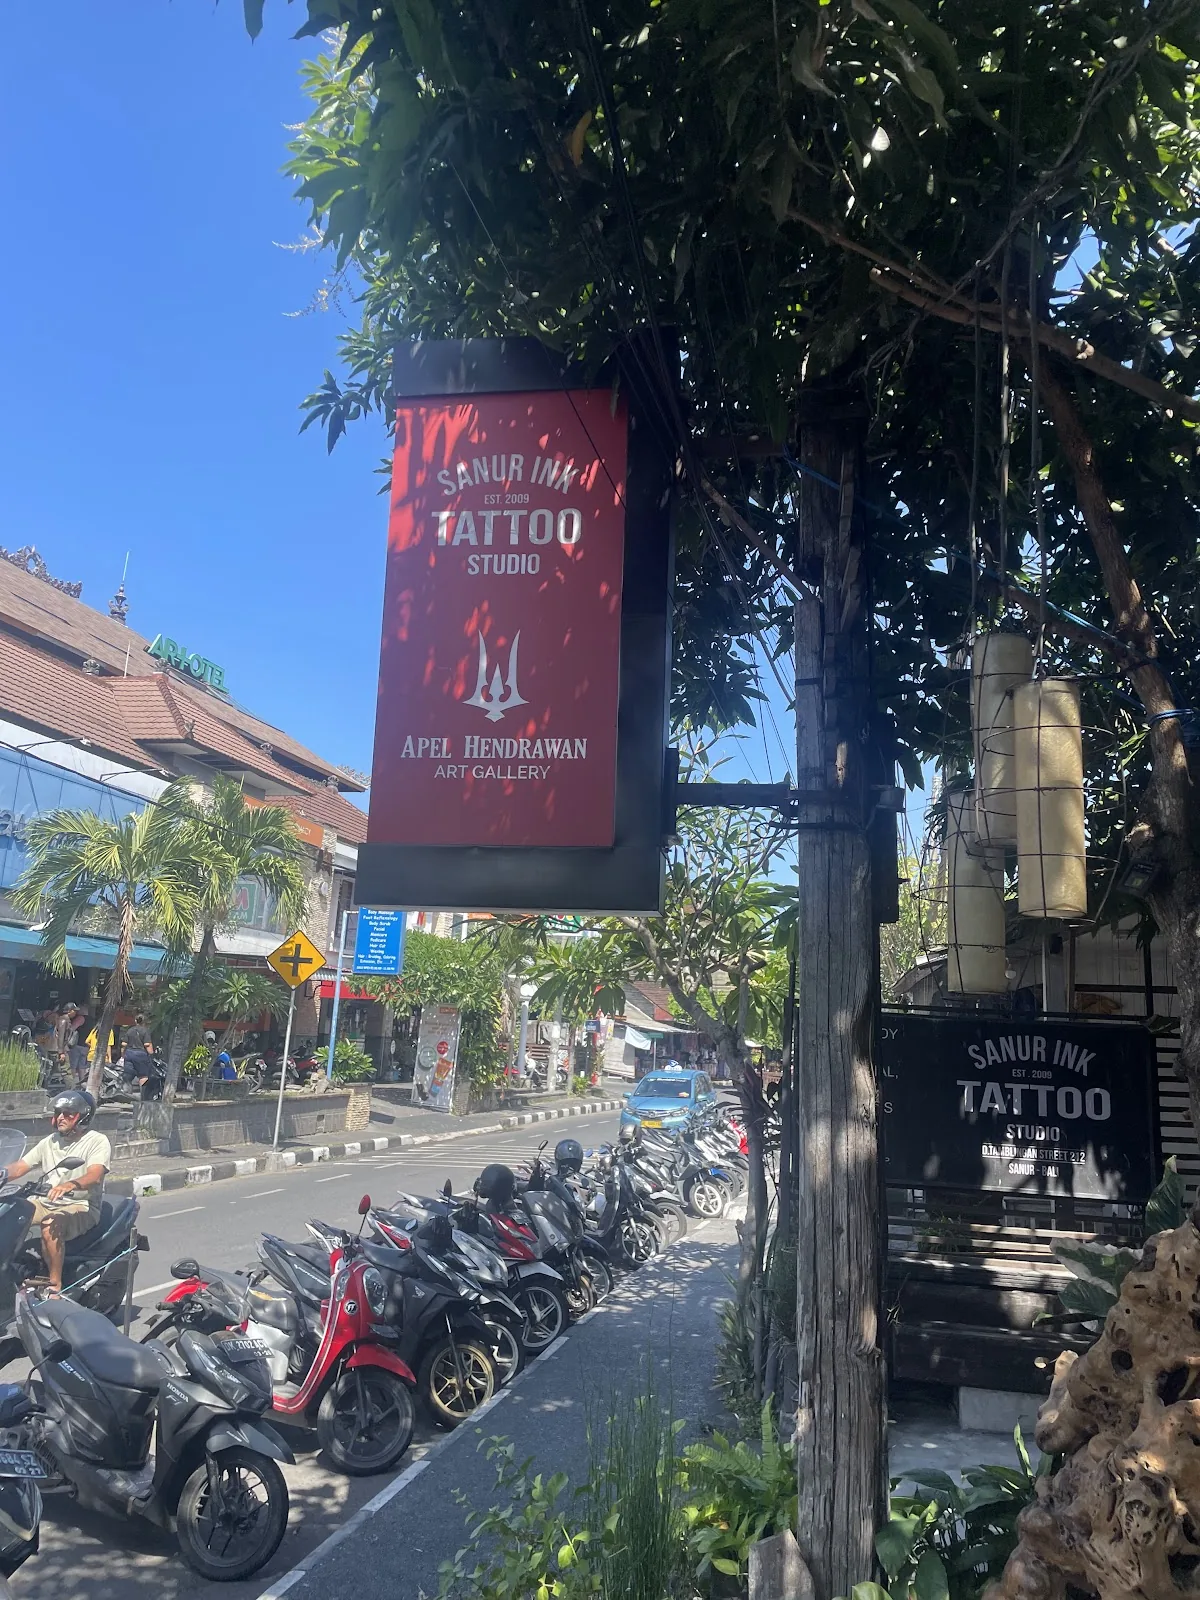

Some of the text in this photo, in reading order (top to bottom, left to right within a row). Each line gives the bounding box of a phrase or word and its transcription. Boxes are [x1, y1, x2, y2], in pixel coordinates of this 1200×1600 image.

[437, 453, 580, 496] SANUR INK
[484, 493, 530, 504] EST. 2009
[431, 508, 583, 546] TATTOO
[467, 553, 541, 575] STUDIO
[400, 735, 588, 760] APEL HENDRAWAN
[434, 765, 551, 781] ART GALLERY
[967, 1035, 1097, 1077] SANUR INK
[1031, 1069, 1052, 1079] 2009
[956, 1080, 1112, 1121] TATTOO
[1006, 1123, 1061, 1141] STUDIO
[1039, 1149, 1069, 1160] STREET
[1069, 1151, 1086, 1162] 212
[1008, 1163, 1035, 1175] SANUR
[1041, 1165, 1060, 1177] BALI
[166, 1382, 189, 1403] HONDA
